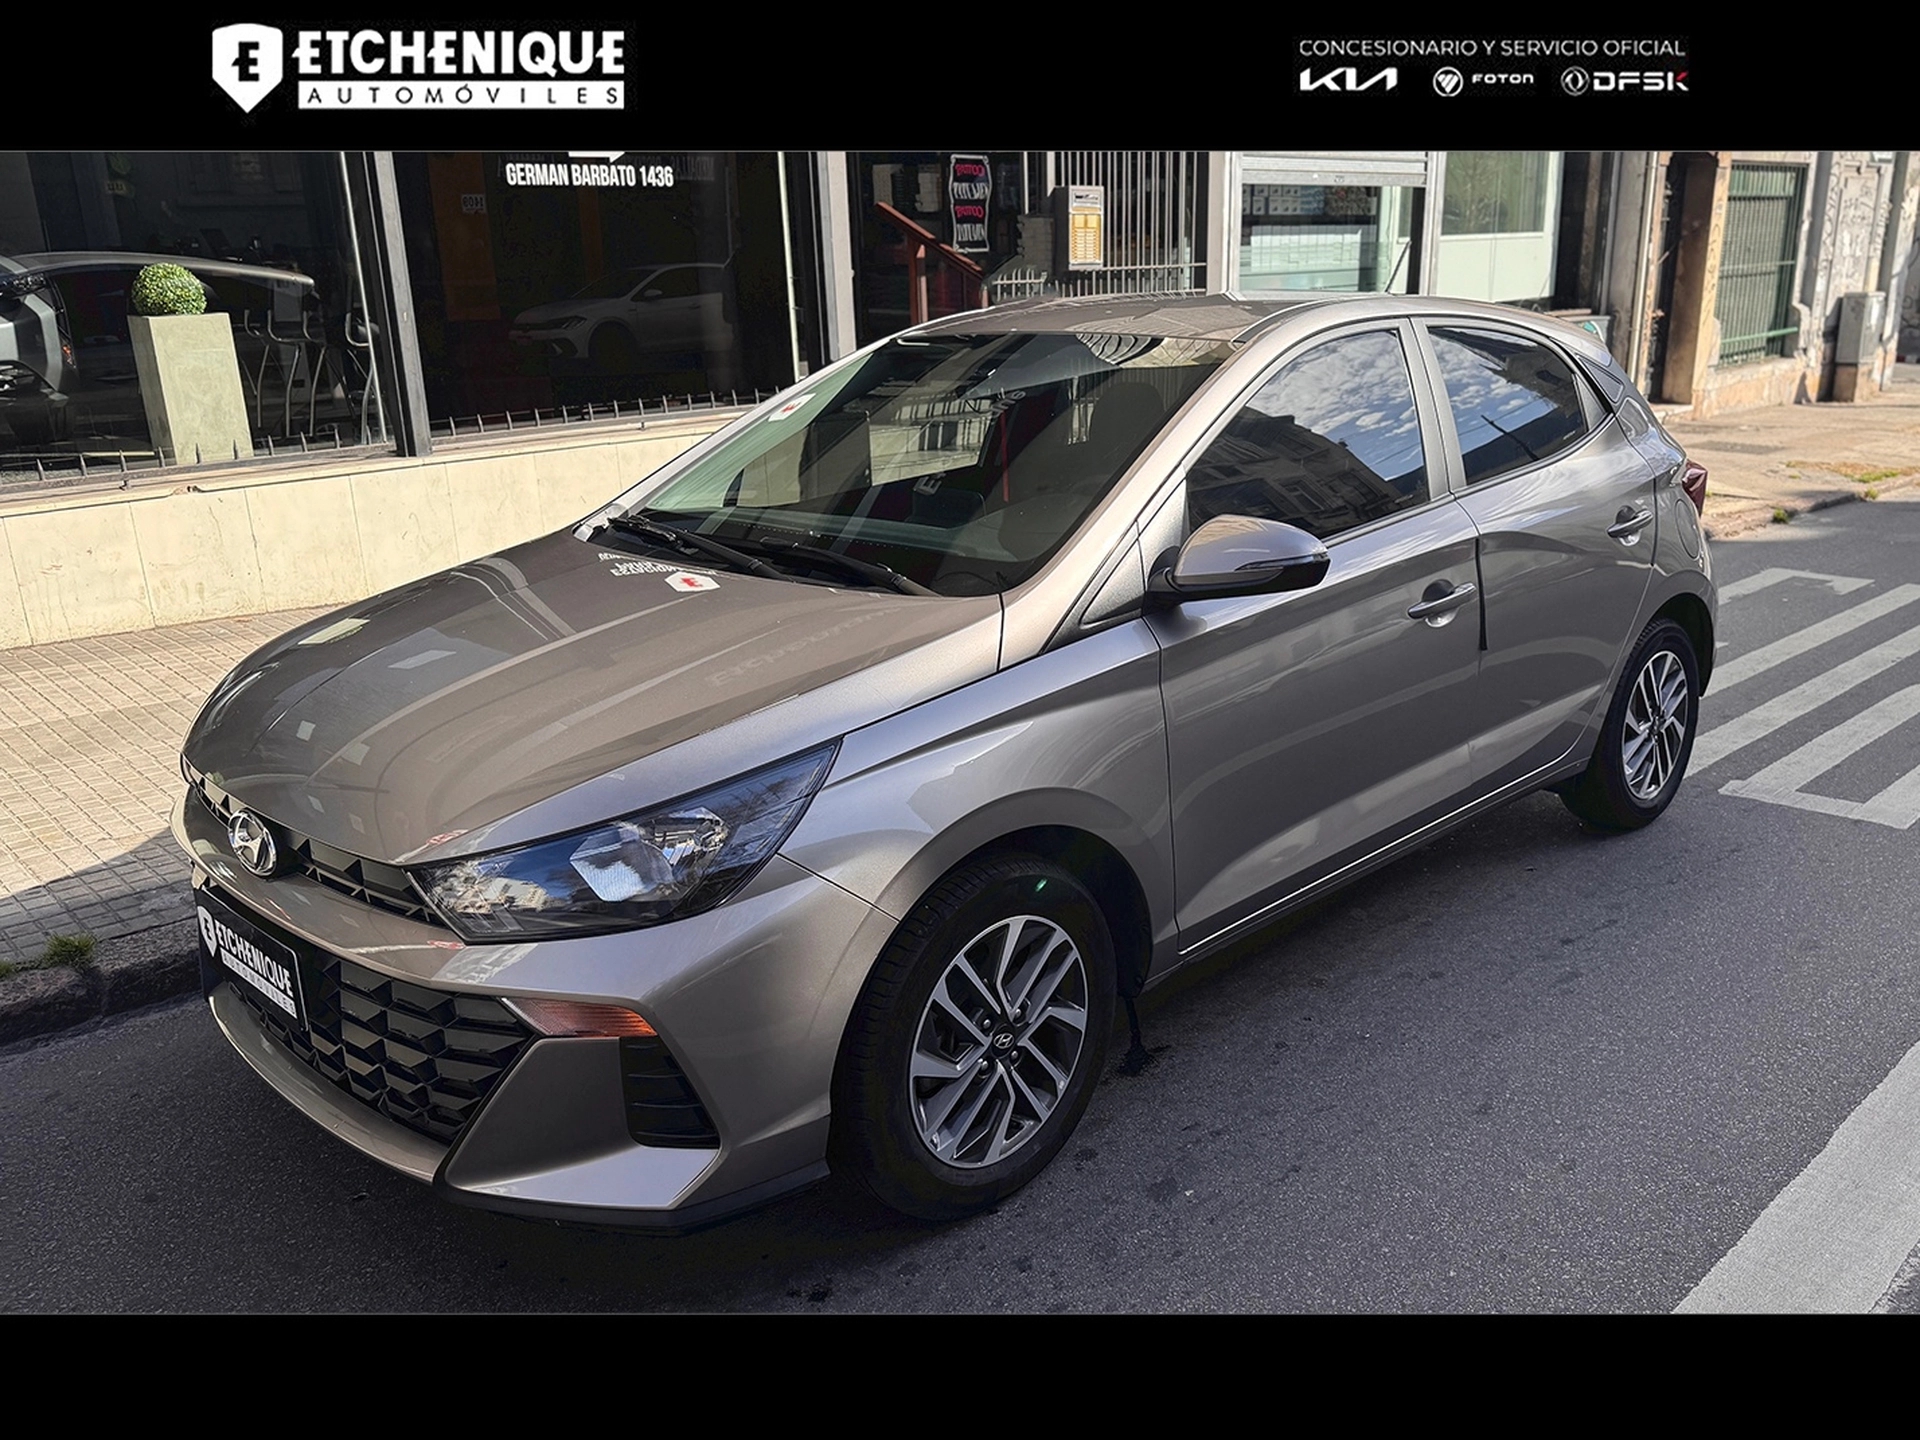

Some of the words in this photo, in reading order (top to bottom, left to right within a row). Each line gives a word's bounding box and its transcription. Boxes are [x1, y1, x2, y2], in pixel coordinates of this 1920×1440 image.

[505, 162, 569, 187] GERMAN
[571, 163, 636, 187] BARBATO
[639, 165, 674, 187] 1436
[214, 918, 294, 998] ETCHENIQUE
